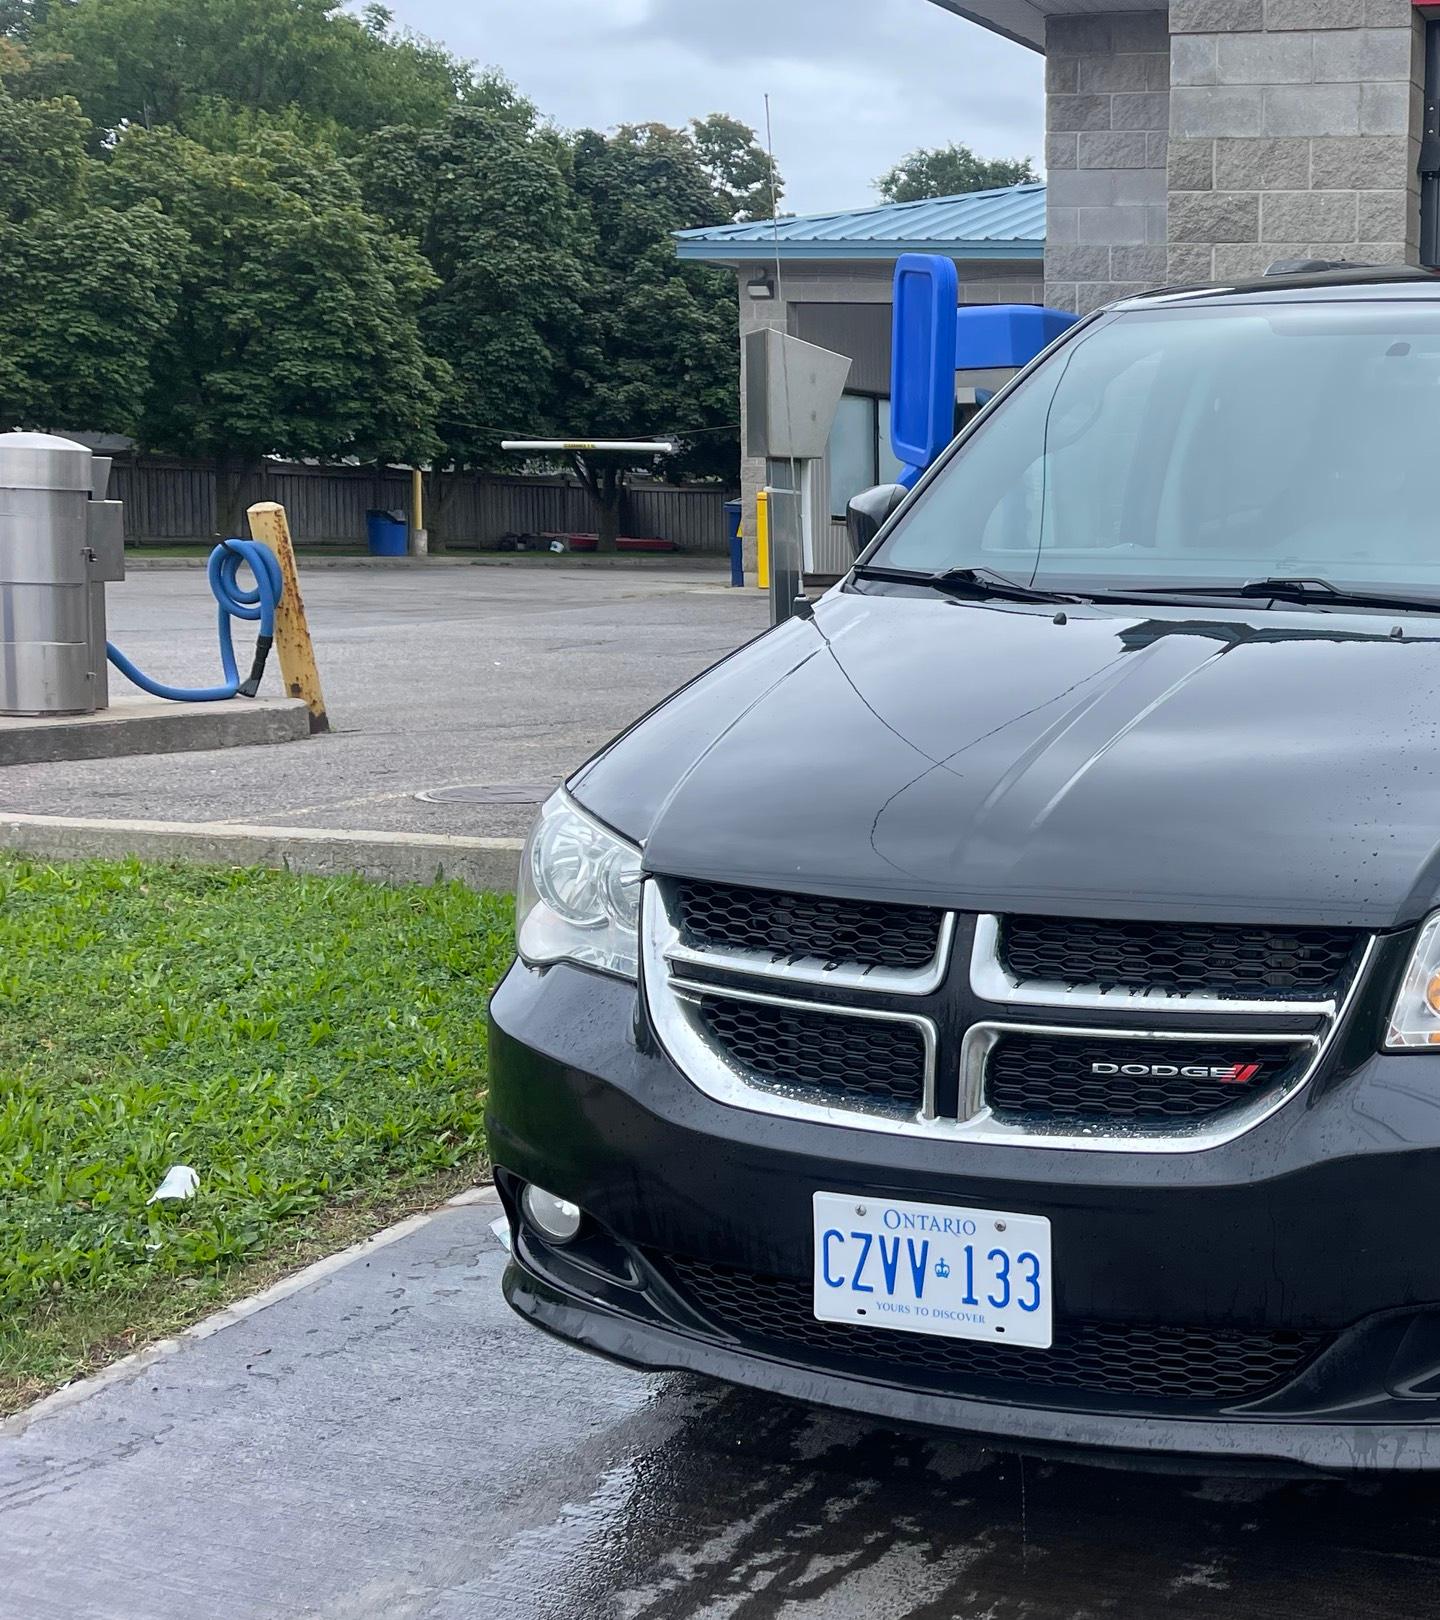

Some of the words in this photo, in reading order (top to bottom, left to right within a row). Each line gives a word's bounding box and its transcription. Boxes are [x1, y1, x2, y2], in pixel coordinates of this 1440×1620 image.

[1092, 1063, 1237, 1078] DODGE
[883, 1209, 976, 1237] ONTARIO
[822, 1229, 930, 1298] CZVV
[961, 1245, 1041, 1312] 133
[876, 1302, 911, 1314] YOURS
[914, 1306, 929, 1317] TO
[932, 1308, 986, 1324] DISCOVER
